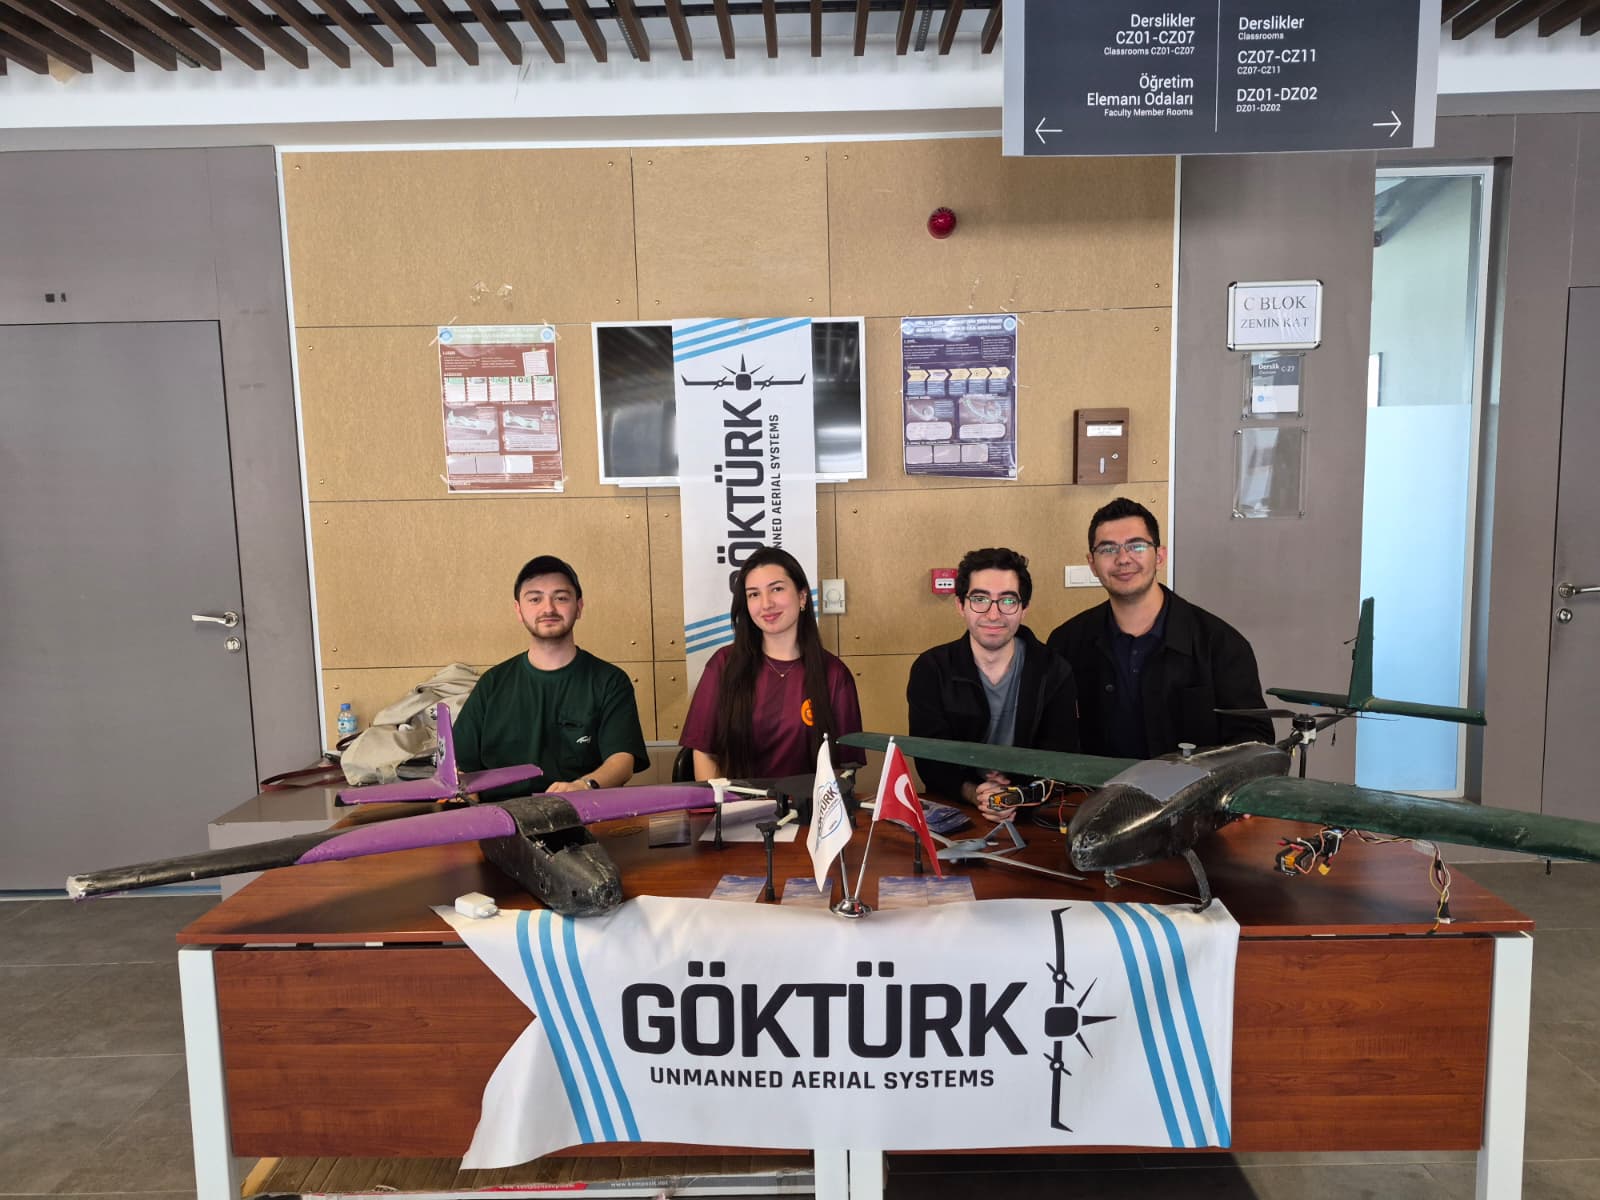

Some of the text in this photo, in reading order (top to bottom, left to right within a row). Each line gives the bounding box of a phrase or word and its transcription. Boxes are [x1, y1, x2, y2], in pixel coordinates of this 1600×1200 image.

[1130, 13, 1195, 28] Derslikler
[1239, 16, 1305, 31] Derslikler
[1115, 31, 1195, 45] CZ01-CZ07
[1238, 32, 1284, 41] Classrooms
[1103, 46, 1195, 56] Classrooms CZ01-CZ07
[1237, 49, 1317, 64] CZ07-CZ11
[1236, 66, 1281, 75] CZ07-CZ11
[1139, 73, 1194, 92] Öğretim
[1087, 91, 1193, 106] Elemanı Odaları
[1236, 87, 1318, 102] DZ01-DZ02
[1104, 107, 1194, 118] Faculty Member Rooms
[1236, 103, 1281, 113] DZ01-DZ02
[1243, 295, 1307, 312] C BLOK
[1282, 316, 1310, 329] KAT
[768, 414, 783, 549] NNED AERIAL SYSTEMS
[714, 398, 766, 594] ÖKTÜRK
[621, 960, 1029, 1059] GÖKTÜRK
[649, 1066, 995, 1091] UNMANNED AERIAL SYSTEMS
